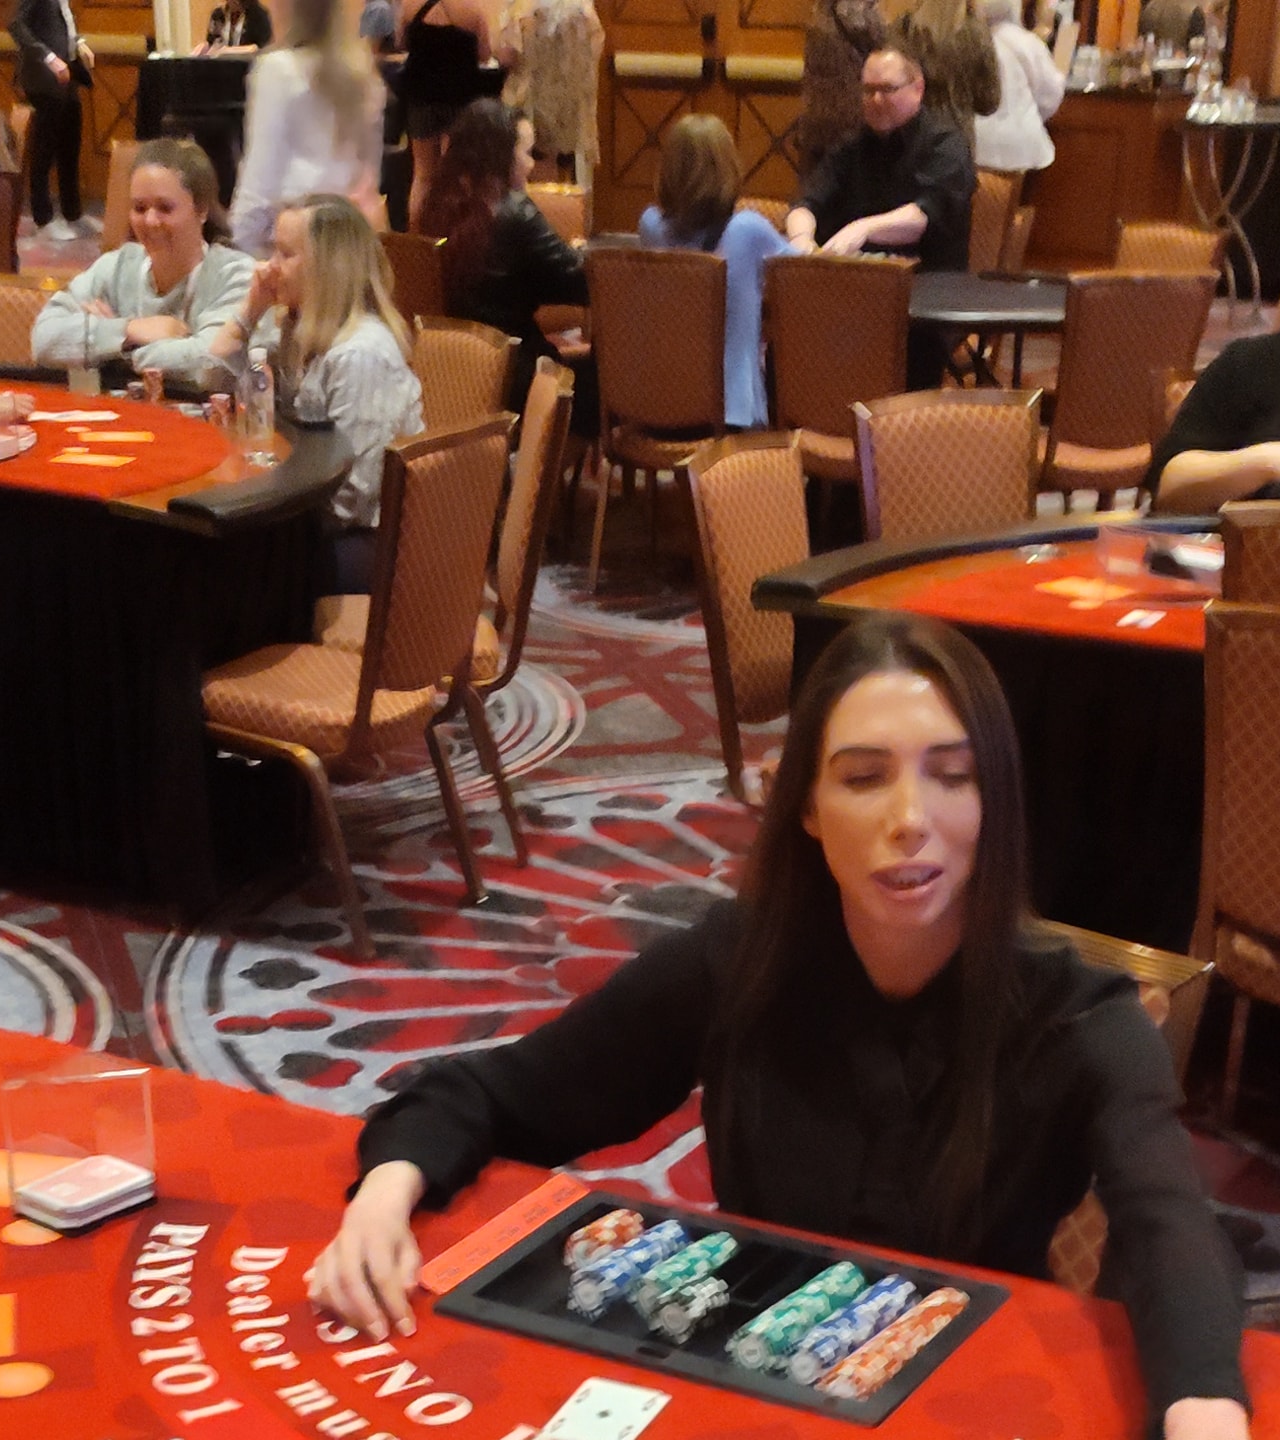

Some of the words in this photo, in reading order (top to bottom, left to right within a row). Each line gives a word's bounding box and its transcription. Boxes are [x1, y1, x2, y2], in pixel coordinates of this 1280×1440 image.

[127, 1221, 211, 1310] PAYS
[129, 1312, 195, 1337] 2
[224, 1243, 302, 1371] Dealer
[137, 1336, 220, 1396] TO
